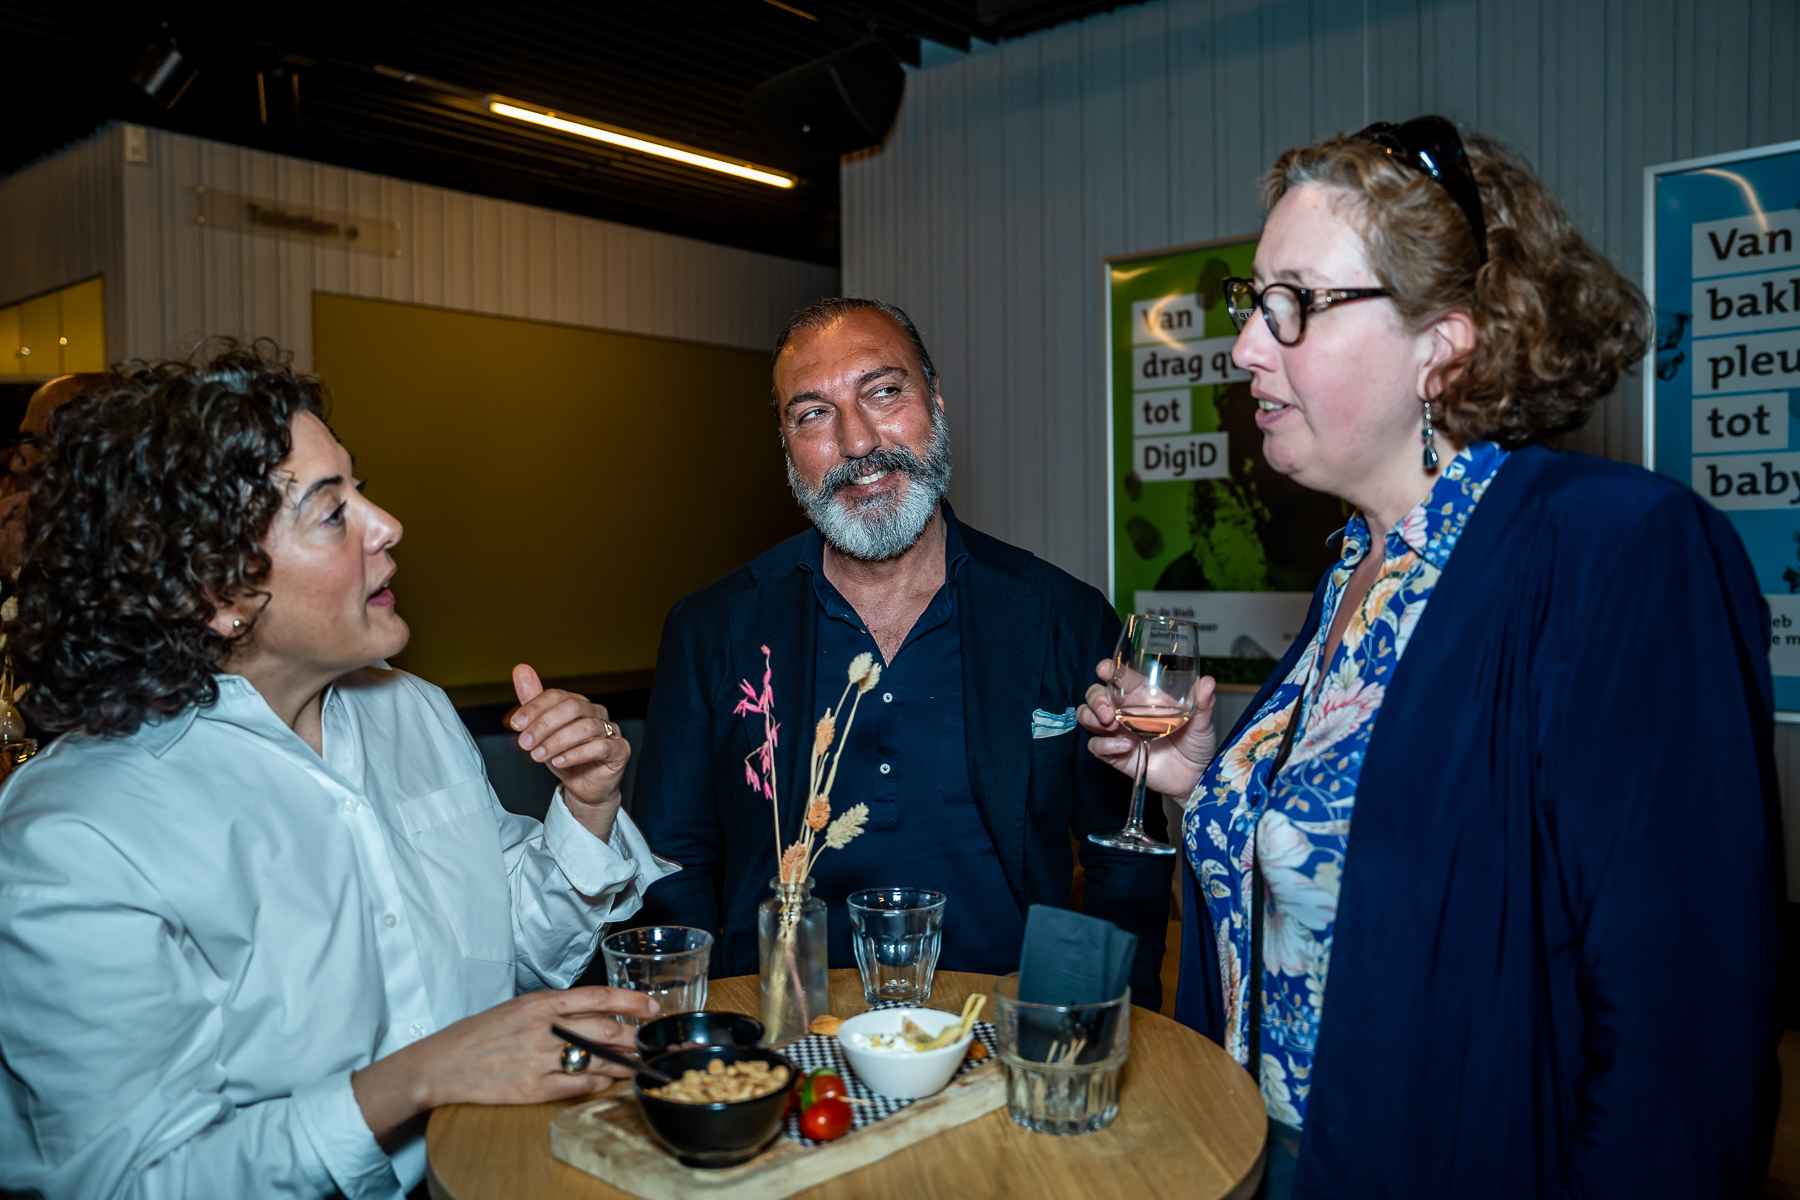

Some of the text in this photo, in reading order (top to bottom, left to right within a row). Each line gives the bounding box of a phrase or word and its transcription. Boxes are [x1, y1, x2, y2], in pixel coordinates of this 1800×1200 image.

[1707, 228, 1792, 260] Van
[1143, 352, 1203, 383] drag
[1144, 397, 1181, 425] tot
[1707, 405, 1770, 438] tot
[1144, 441, 1217, 477] DigiD
